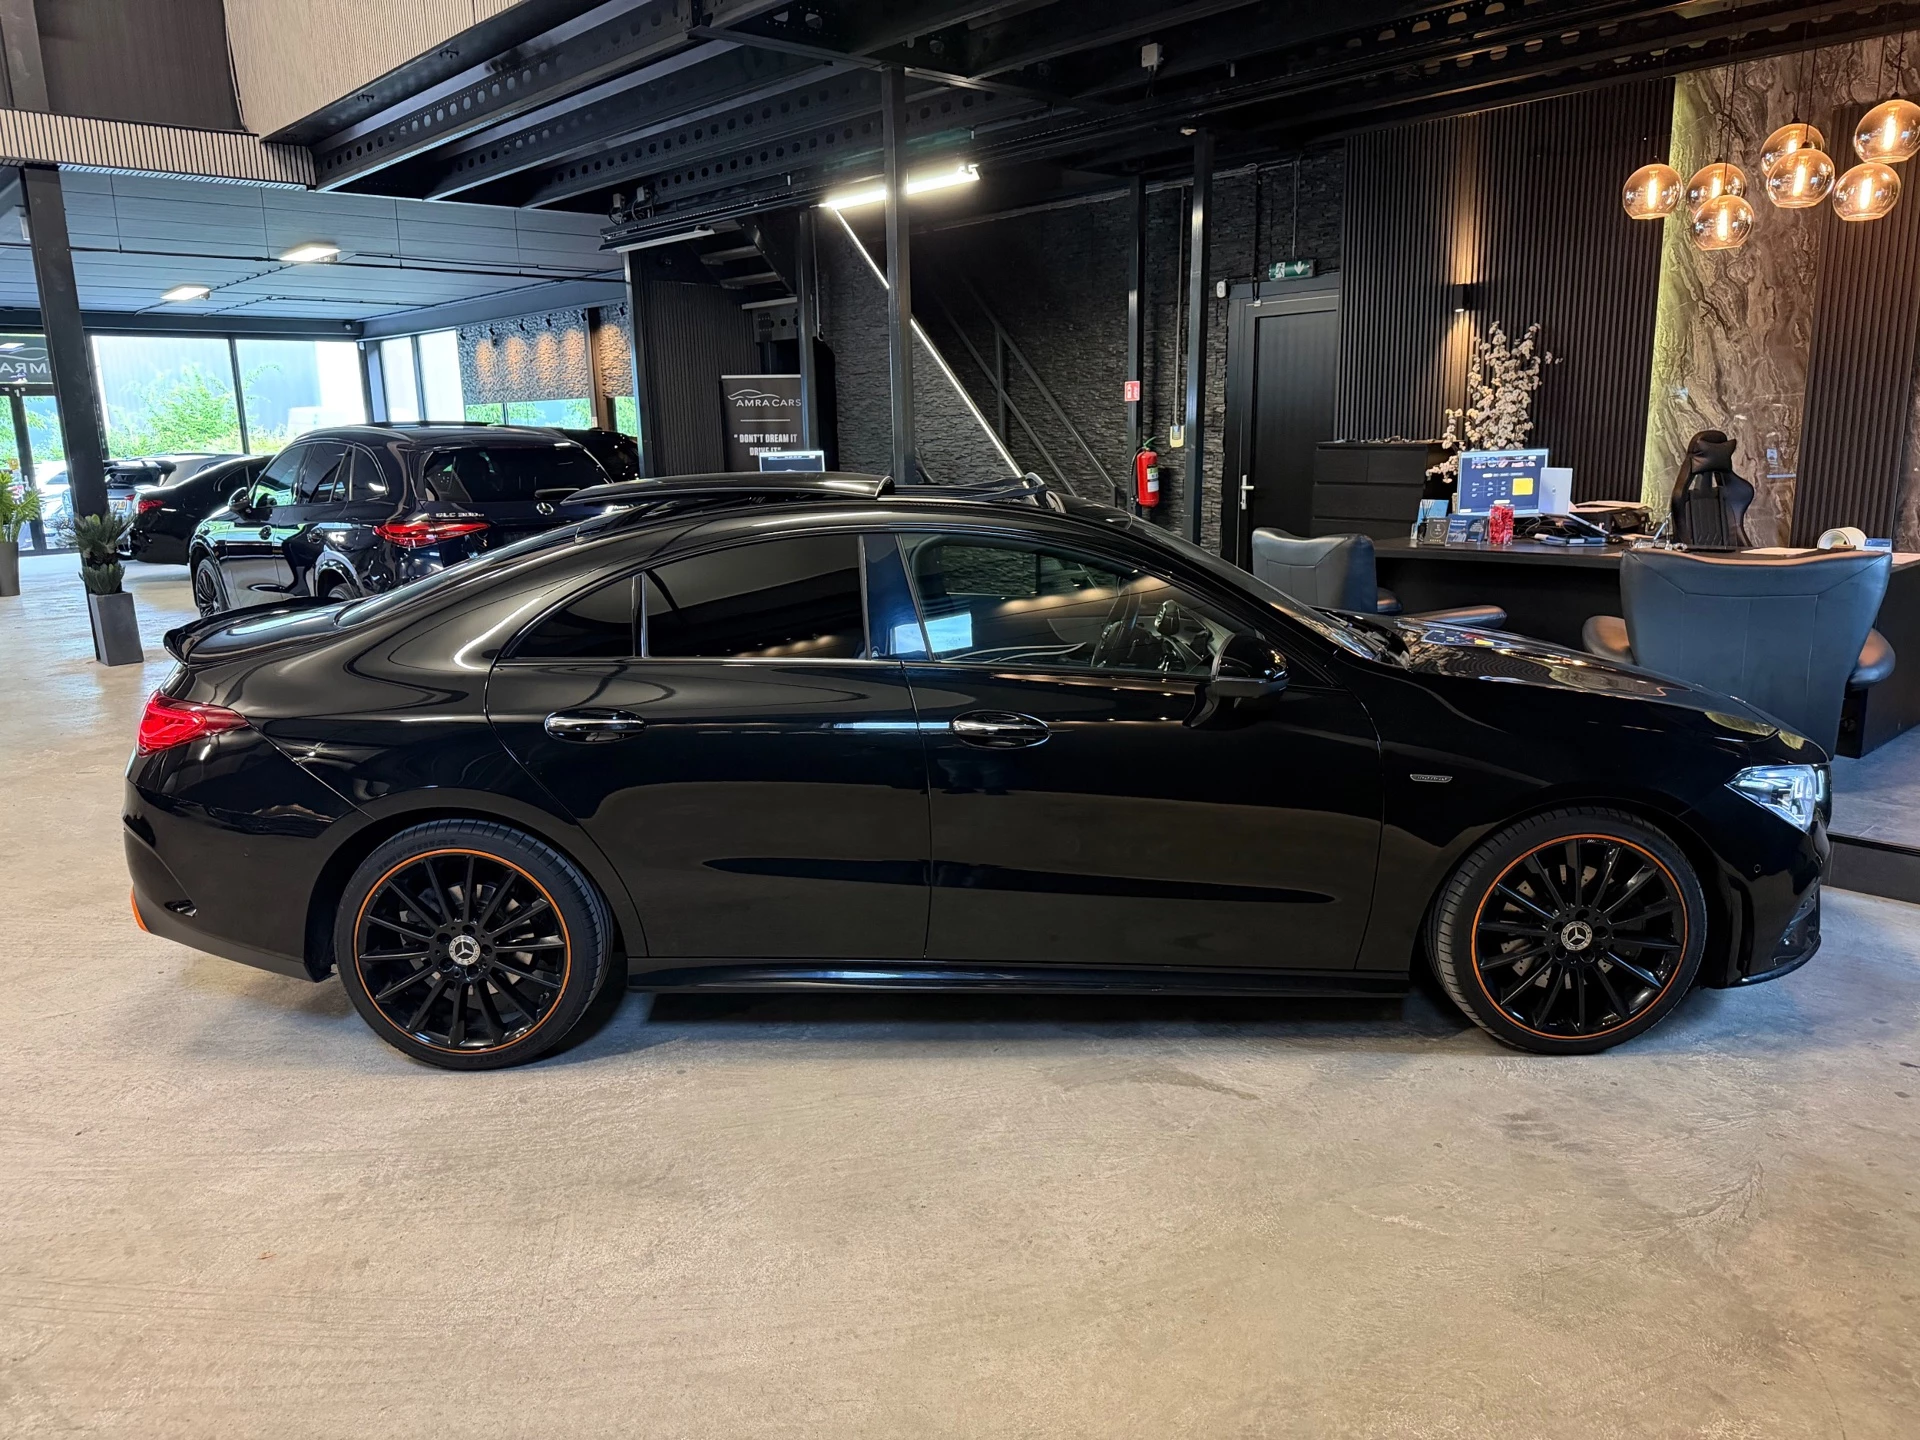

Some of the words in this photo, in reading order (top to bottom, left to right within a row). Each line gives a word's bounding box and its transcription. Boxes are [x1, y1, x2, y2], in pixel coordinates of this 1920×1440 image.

[736, 399, 770, 407] AMRA
[771, 399, 802, 407] CARS
[765, 433, 789, 443] DREAM
[790, 433, 798, 443] IT
